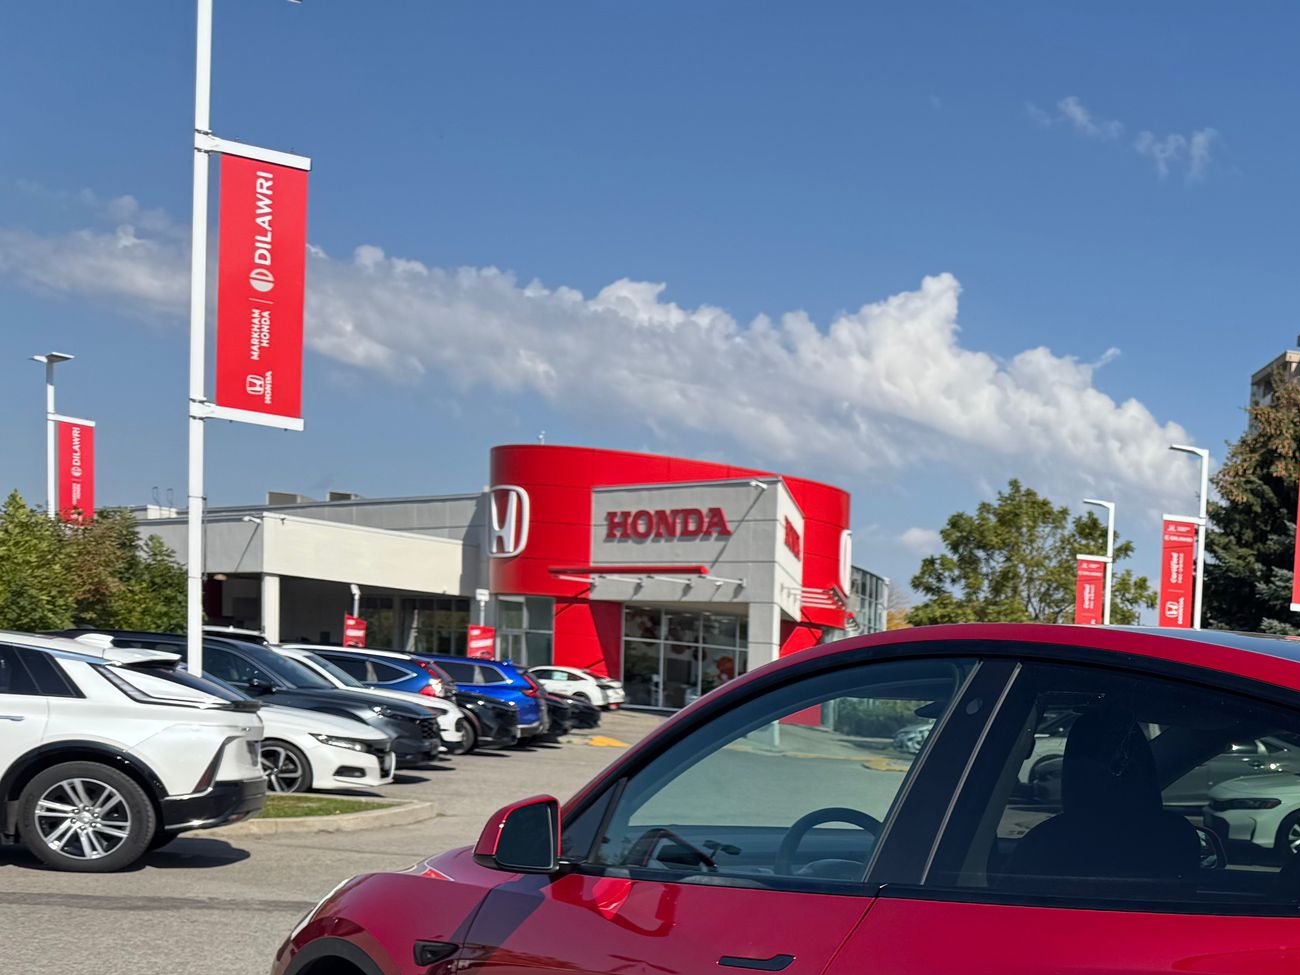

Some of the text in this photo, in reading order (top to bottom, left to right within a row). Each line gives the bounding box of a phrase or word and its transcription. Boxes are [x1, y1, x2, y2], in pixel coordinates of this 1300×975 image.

[254, 170, 274, 266] DILAWRI
[250, 308, 261, 361] MARKHAM
[260, 310, 271, 348] HONDA
[264, 370, 273, 405] HONDA
[605, 507, 733, 540] HONDA
